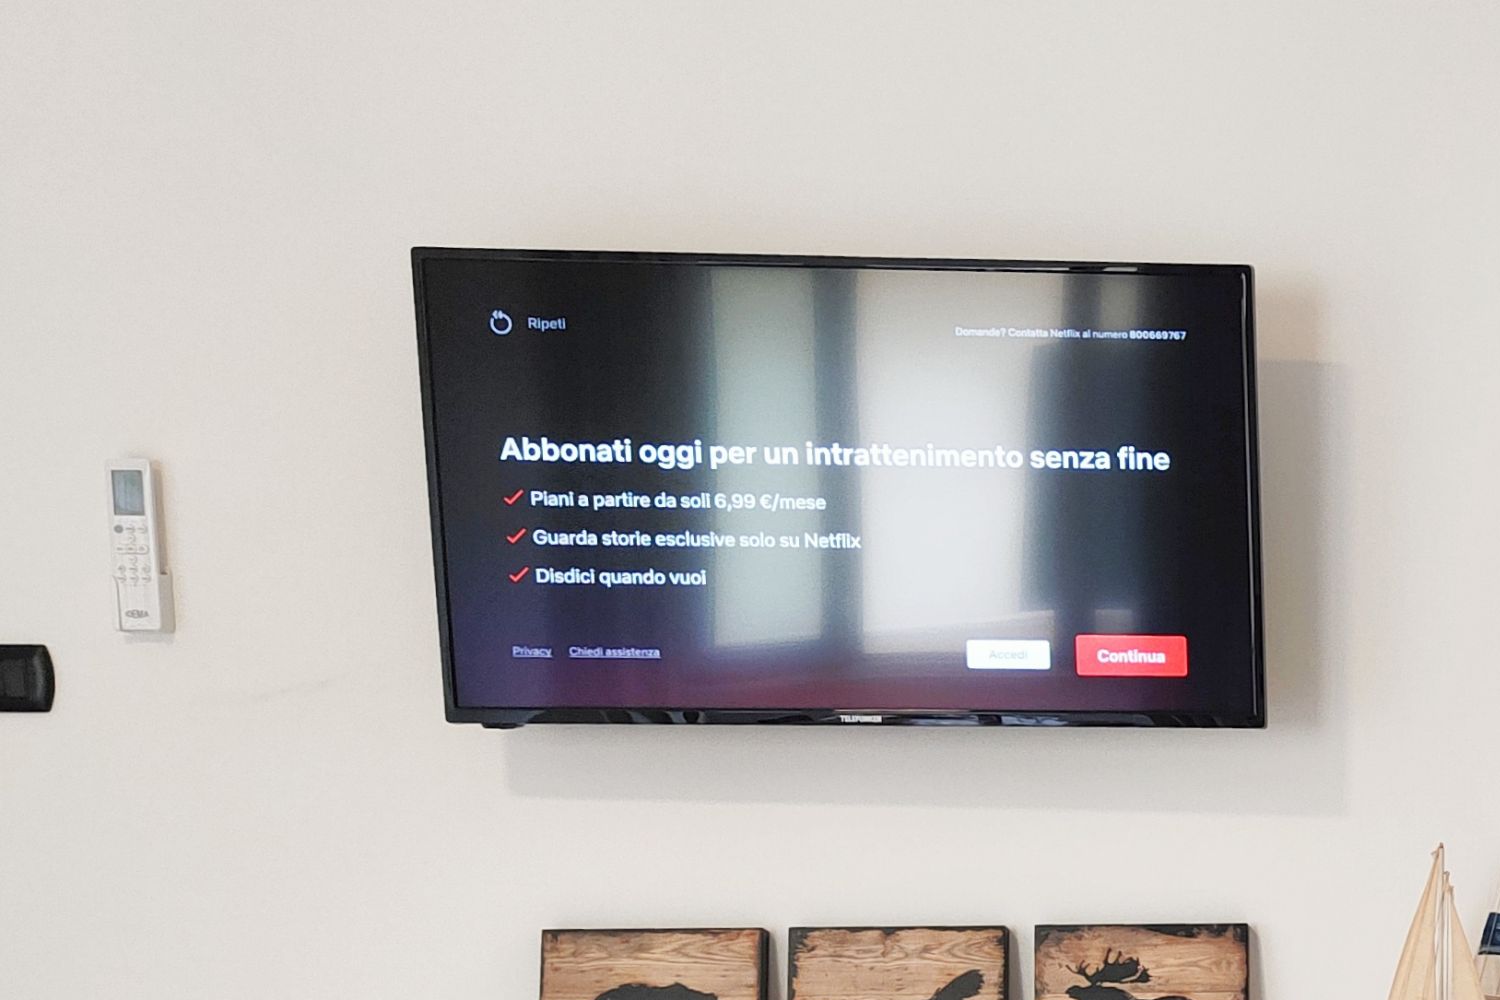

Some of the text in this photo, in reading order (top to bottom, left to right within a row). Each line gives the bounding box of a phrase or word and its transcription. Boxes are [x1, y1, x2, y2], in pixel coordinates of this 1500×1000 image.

[527, 317, 566, 332] Ripeti
[955, 326, 1005, 338] Domande?
[1008, 327, 1049, 338] Contatta
[1050, 328, 1081, 339] Netflix
[1082, 329, 1091, 339] al
[1092, 331, 1128, 340] numero
[500, 437, 1171, 471] Abbonati oggi per un intrattenimento senza fine
[530, 491, 827, 512] Piani a partire da soli 6,99 €/mese
[532, 529, 862, 549] Guarda storie esclusive solo su Netflix
[535, 568, 707, 588] Disdici quando vuoi
[512, 646, 552, 657] Privacy
[568, 646, 661, 658] Chiedi assistenza
[988, 649, 1029, 661] Accedi
[1096, 648, 1166, 664] Continua
